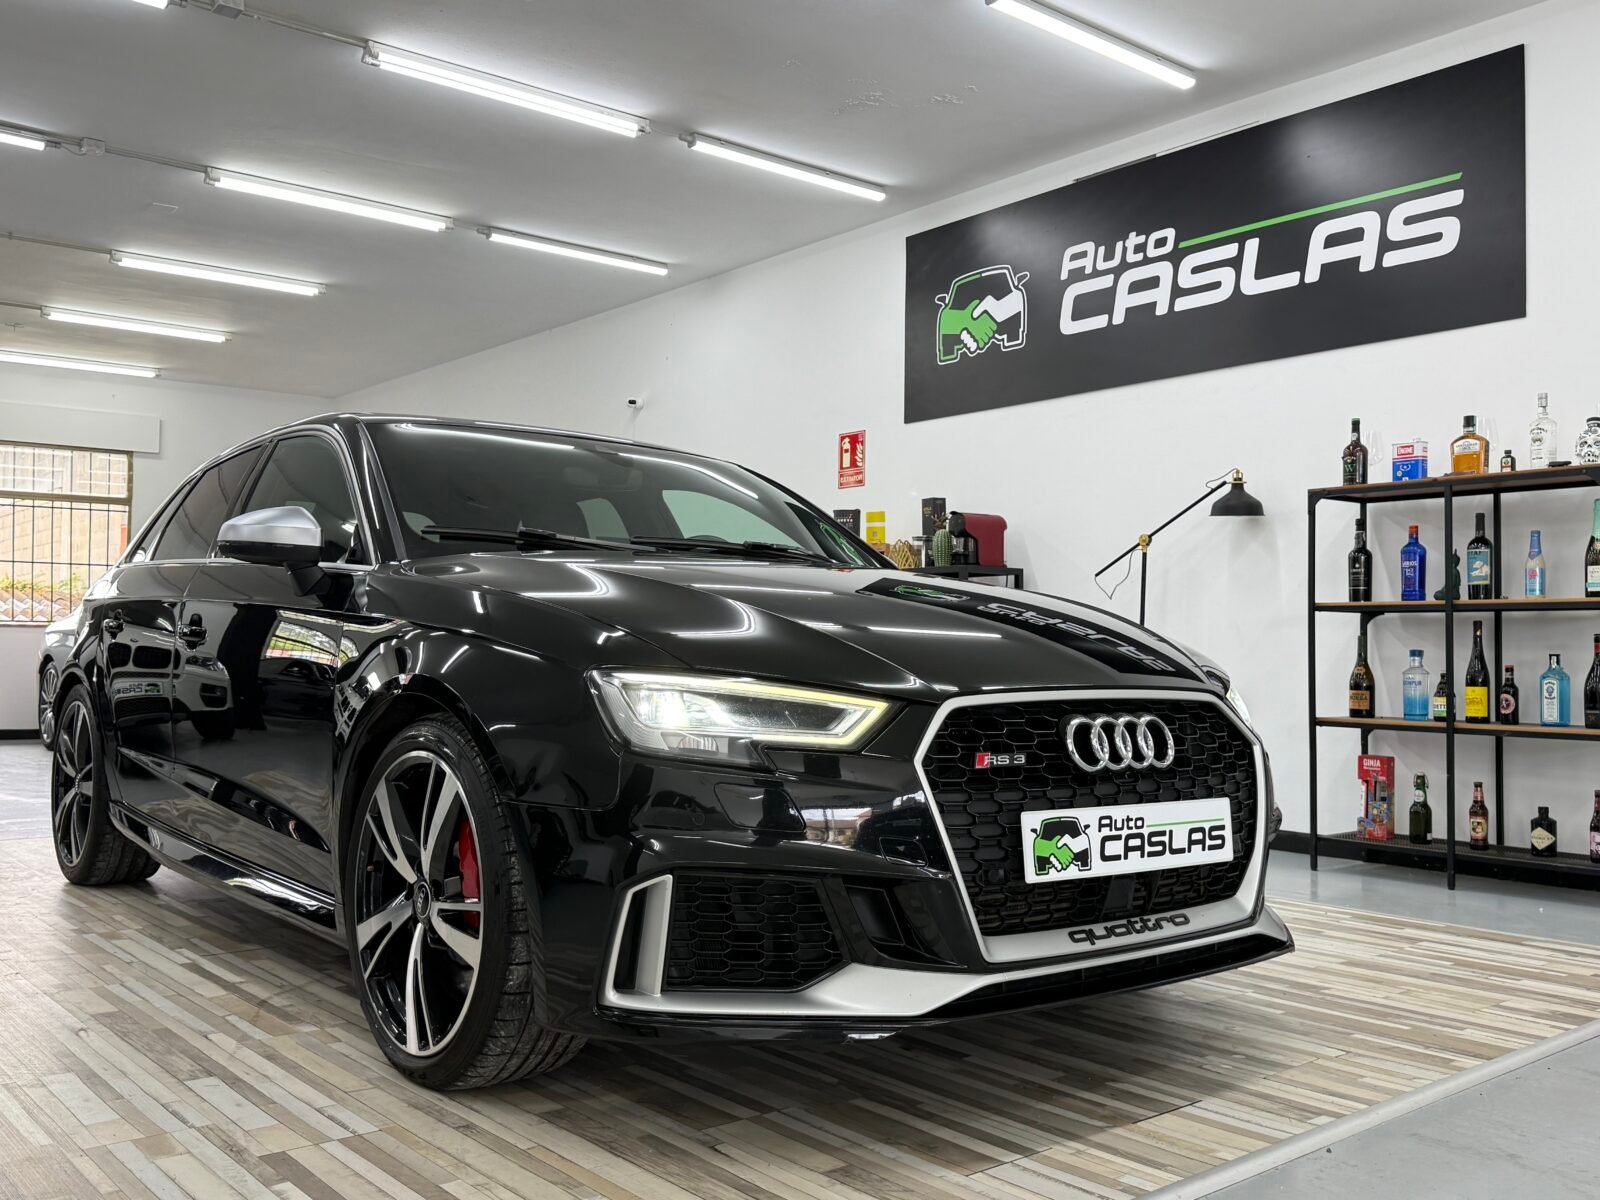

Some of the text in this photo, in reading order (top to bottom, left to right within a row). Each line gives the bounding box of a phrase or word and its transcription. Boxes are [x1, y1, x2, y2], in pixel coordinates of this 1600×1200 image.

[1060, 189, 1464, 336] CASLAS
[1061, 227, 1176, 281] Auto
[984, 754, 1026, 766] RS 3
[1363, 759, 1381, 767] GINJA
[1098, 815, 1145, 833] Auto
[1100, 825, 1226, 862] CASLAS
[1068, 913, 1190, 945] quattro
